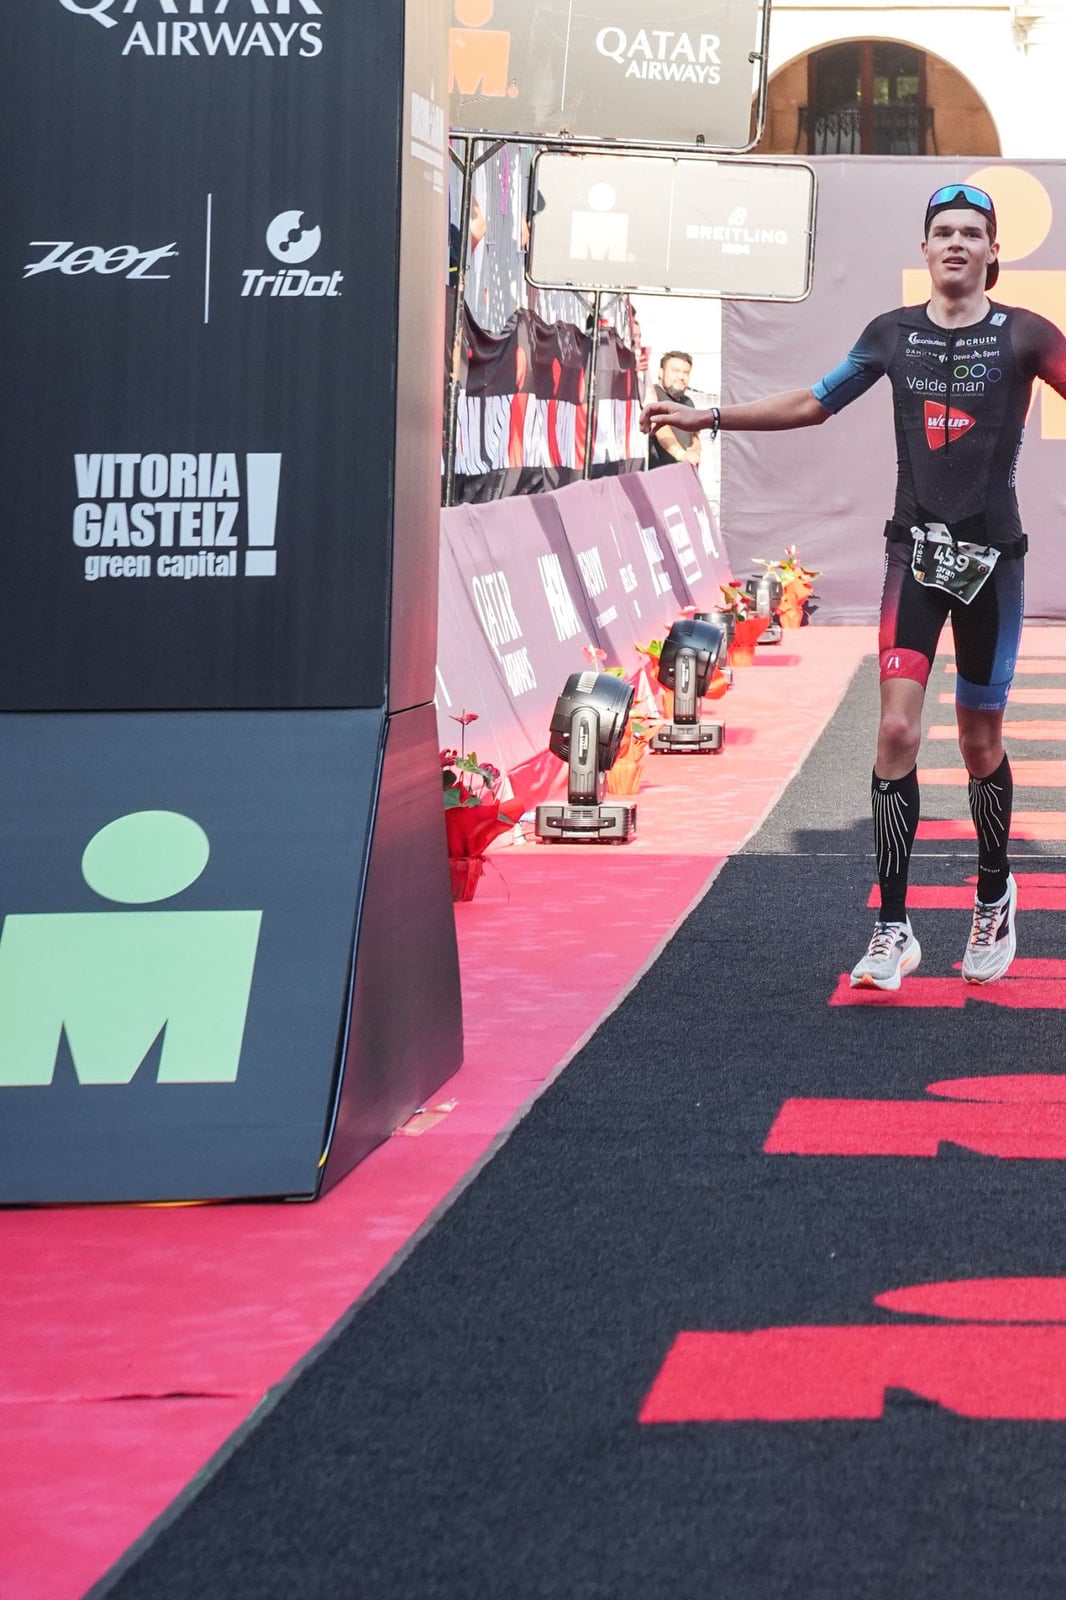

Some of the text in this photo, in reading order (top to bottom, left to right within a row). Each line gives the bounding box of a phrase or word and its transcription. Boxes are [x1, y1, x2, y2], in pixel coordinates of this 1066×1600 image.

[122, 21, 323, 57] AIRWAYS
[595, 27, 722, 65] QATAR
[625, 60, 722, 85] AIRWAYS
[686, 224, 789, 245] BREITLING
[240, 269, 344, 297] TriDot
[74, 452, 241, 498] VITORIA
[72, 501, 239, 547] GASTEIZ
[84, 550, 238, 581] green capital
